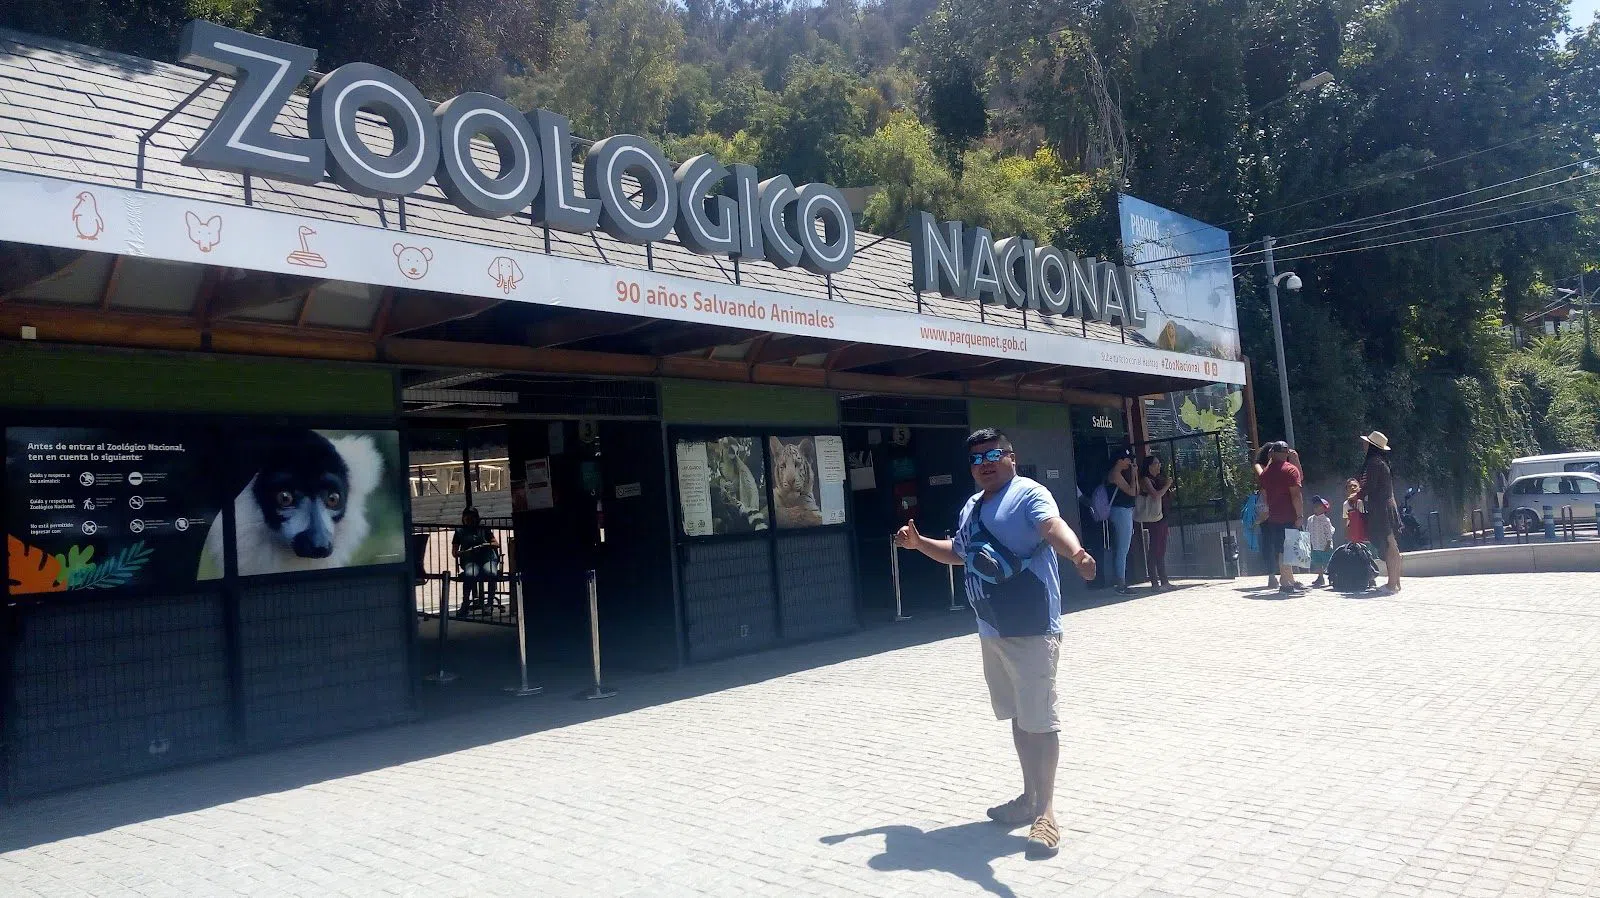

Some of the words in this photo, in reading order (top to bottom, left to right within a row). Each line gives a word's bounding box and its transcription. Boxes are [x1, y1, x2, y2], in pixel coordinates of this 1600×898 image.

[178, 18, 855, 275] ZOOLOGICO
[911, 210, 1147, 328] NACIONAL
[1130, 213, 1159, 242] PARQUE
[616, 280, 641, 304] 90
[646, 285, 688, 310] años
[693, 290, 766, 321] Salvando
[770, 302, 835, 329] Animales
[919, 325, 1029, 353] www.parquemet.gob.cl
[1161, 357, 1200, 373] #ZooNacional
[1092, 415, 1113, 429] Salida
[27, 442, 54, 450] Antes
[55, 442, 67, 450] de
[68, 443, 96, 451] entrar
[97, 442, 106, 451] al
[106, 443, 147, 453] Zoológico
[147, 443, 186, 453] Nacional,
[28, 453, 44, 461] ten
[59, 453, 89, 461] cuenta
[90, 453, 99, 461] lo
[101, 453, 143, 463] siguiente:
